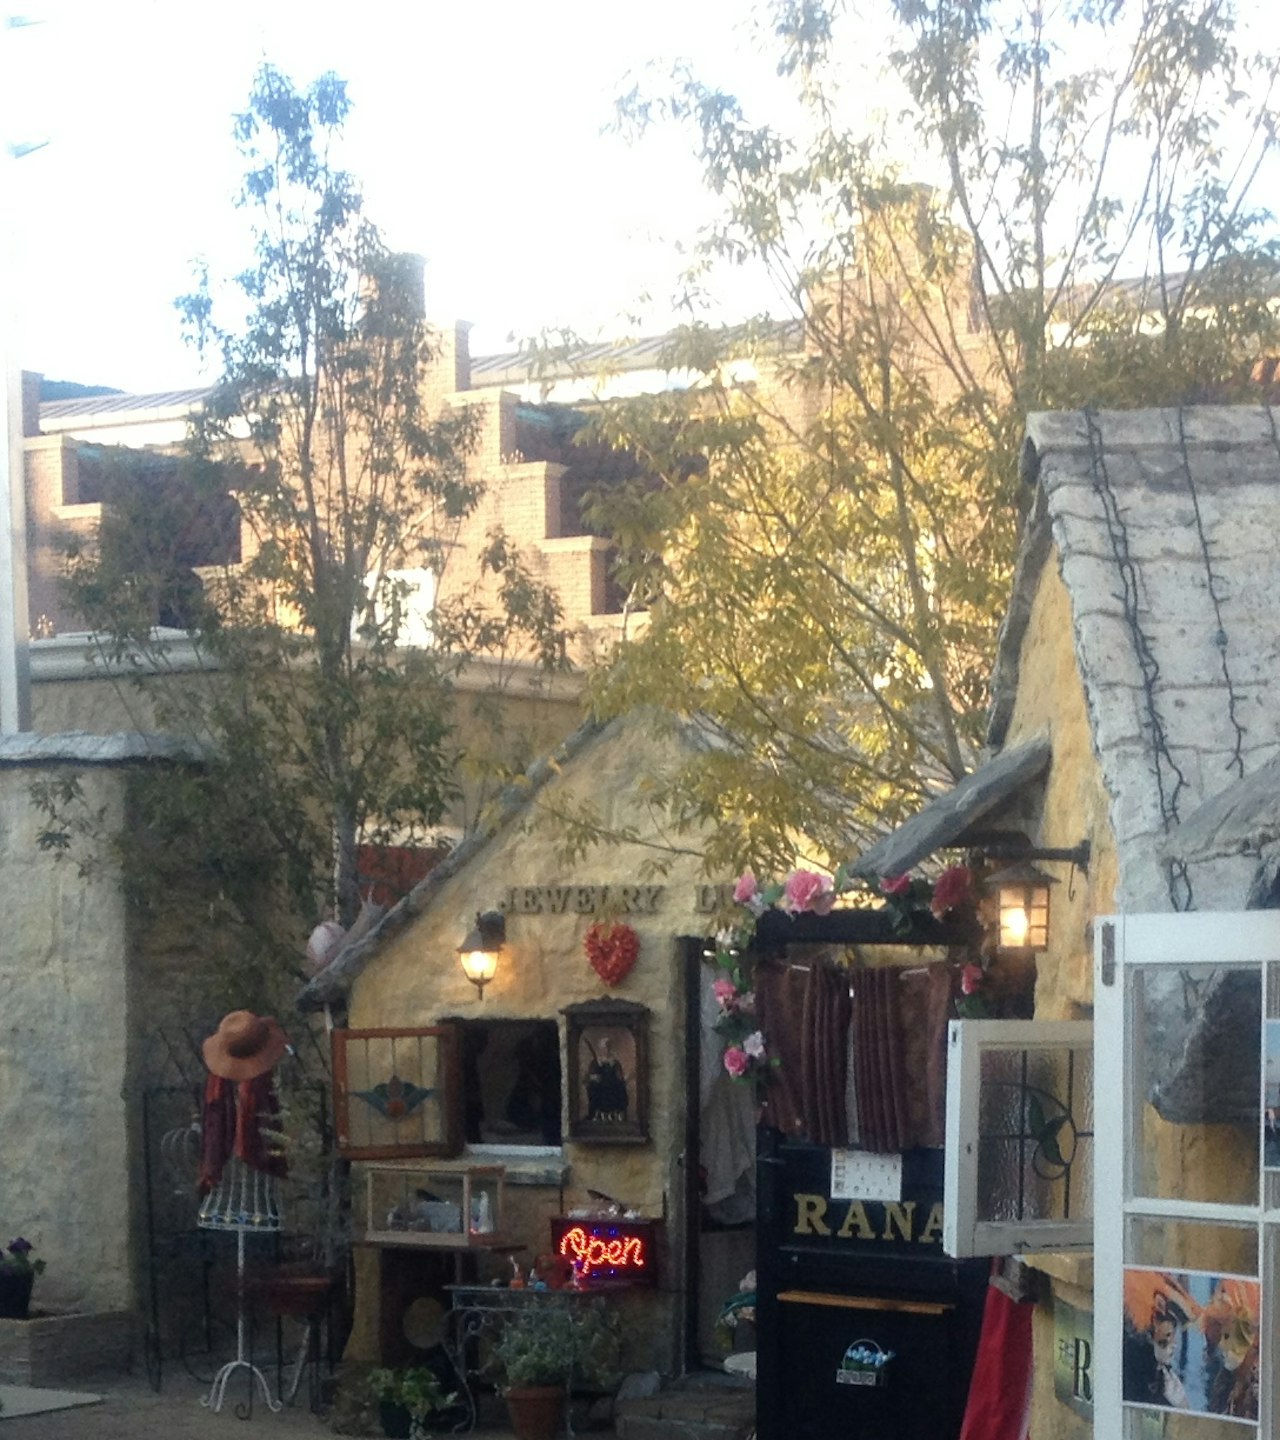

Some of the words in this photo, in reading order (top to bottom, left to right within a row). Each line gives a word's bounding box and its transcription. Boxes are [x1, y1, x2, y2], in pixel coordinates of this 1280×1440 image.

[499, 884, 666, 914] JEWELRY
[793, 1193, 944, 1243] RANA
[561, 1227, 643, 1275] Open
